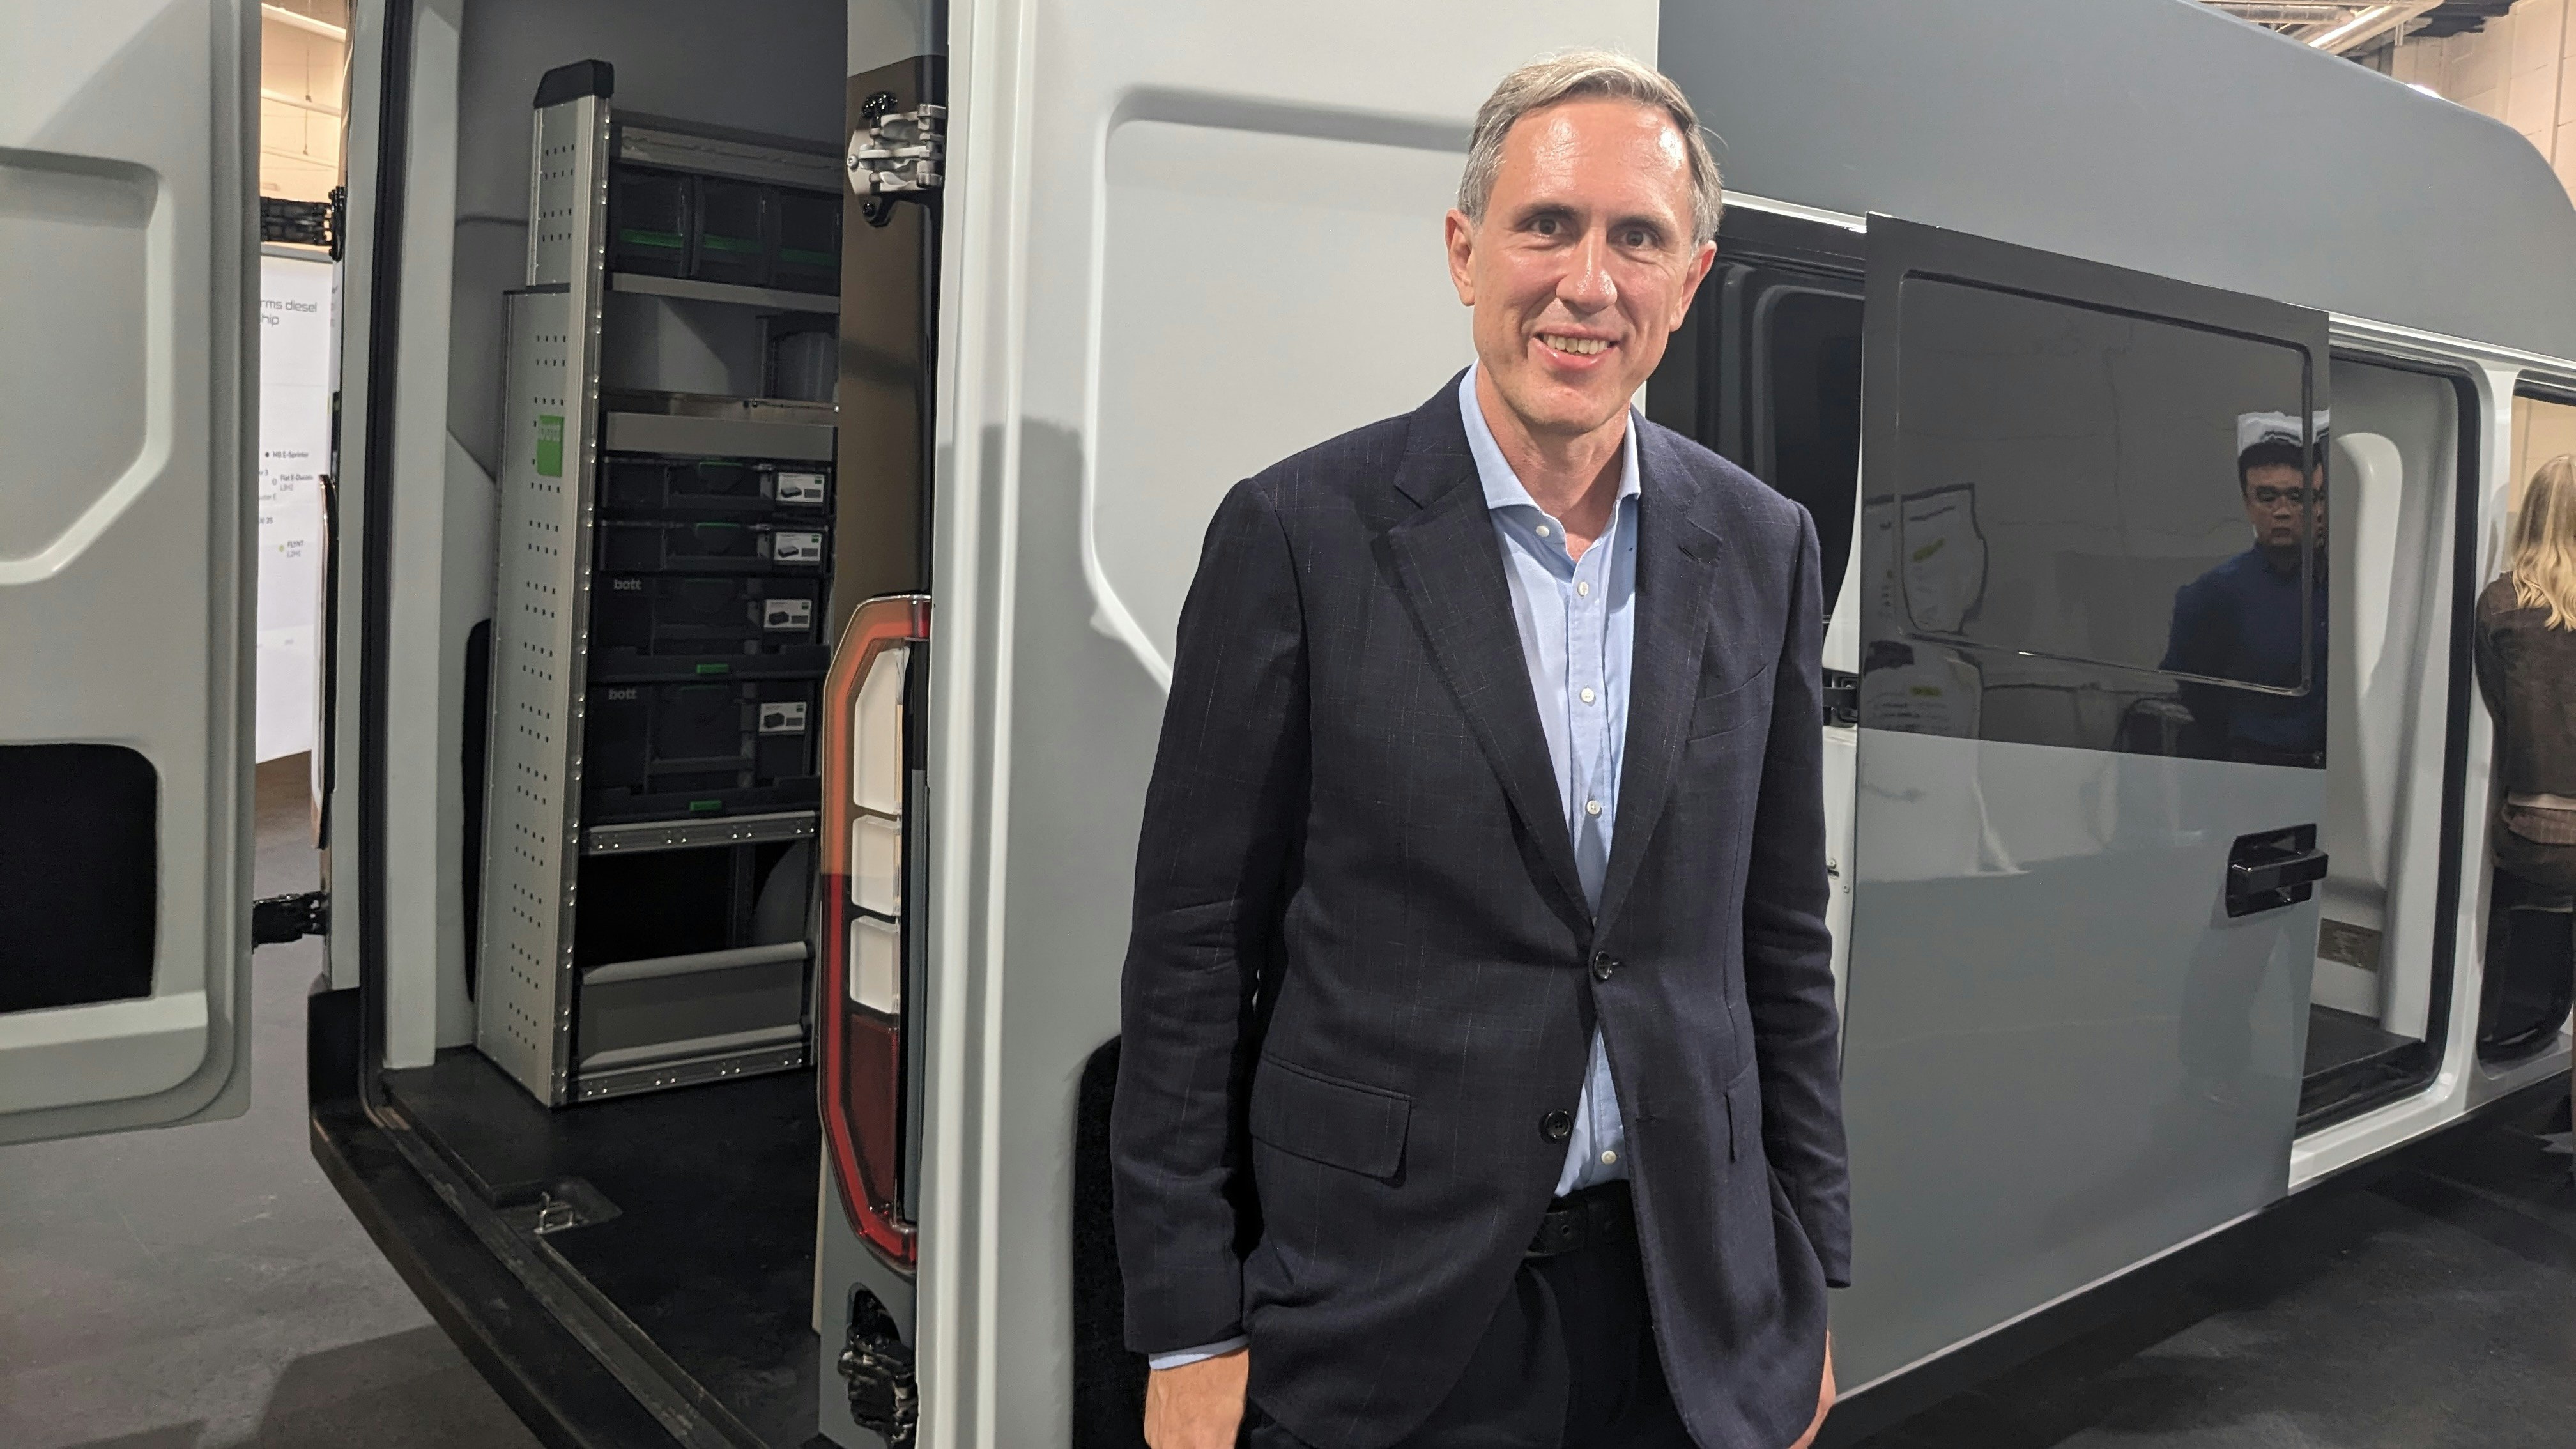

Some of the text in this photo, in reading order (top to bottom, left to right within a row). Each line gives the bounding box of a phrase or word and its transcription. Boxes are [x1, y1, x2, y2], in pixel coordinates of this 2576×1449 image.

[286, 300, 317, 312] diesel
[614, 579, 641, 590] bott
[609, 689, 638, 700] bott
